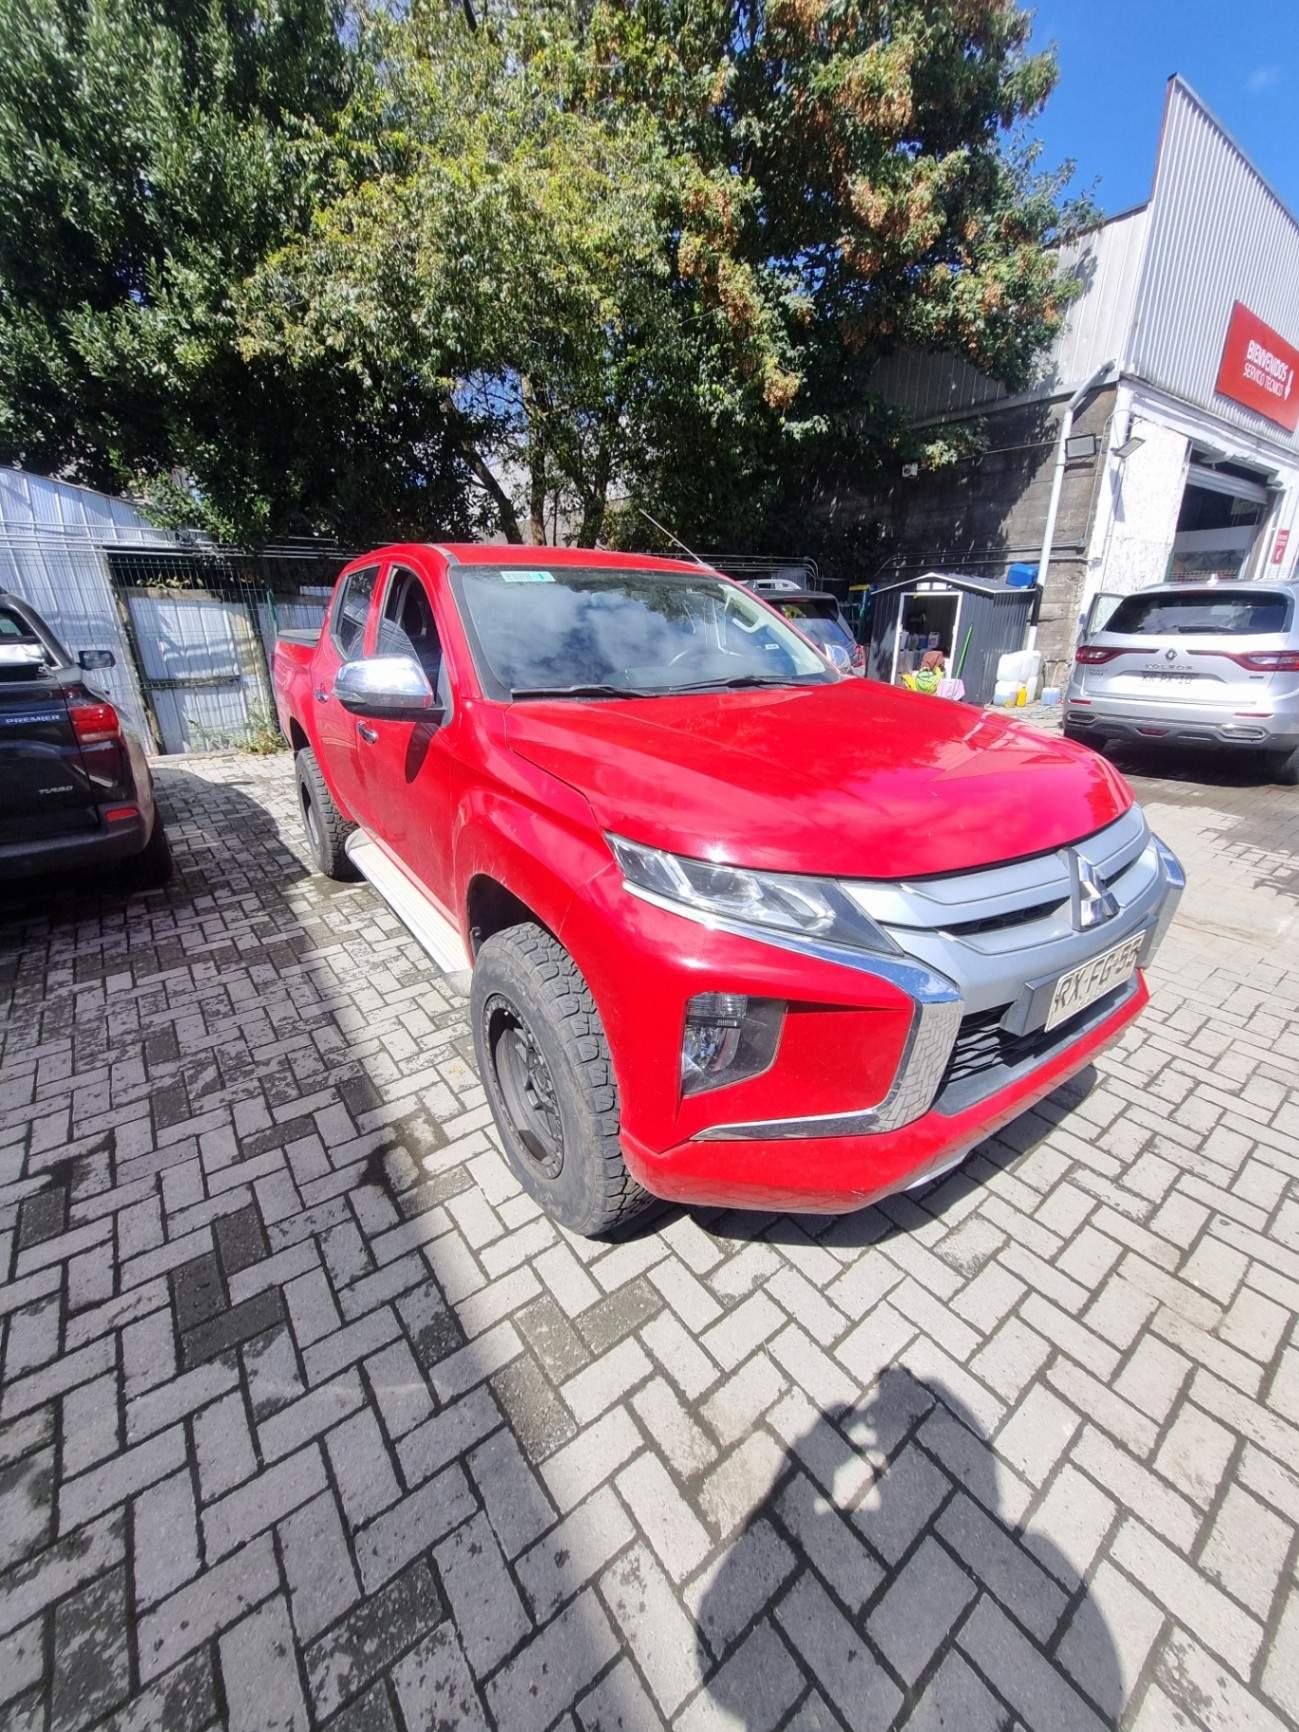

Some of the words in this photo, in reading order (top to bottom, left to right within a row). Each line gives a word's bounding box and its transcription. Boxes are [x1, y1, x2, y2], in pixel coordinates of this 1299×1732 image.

[1246, 340, 1288, 382] BIENVENIDOS
[6, 715, 60, 724] PREMIER
[39, 785, 73, 794] TURBO
